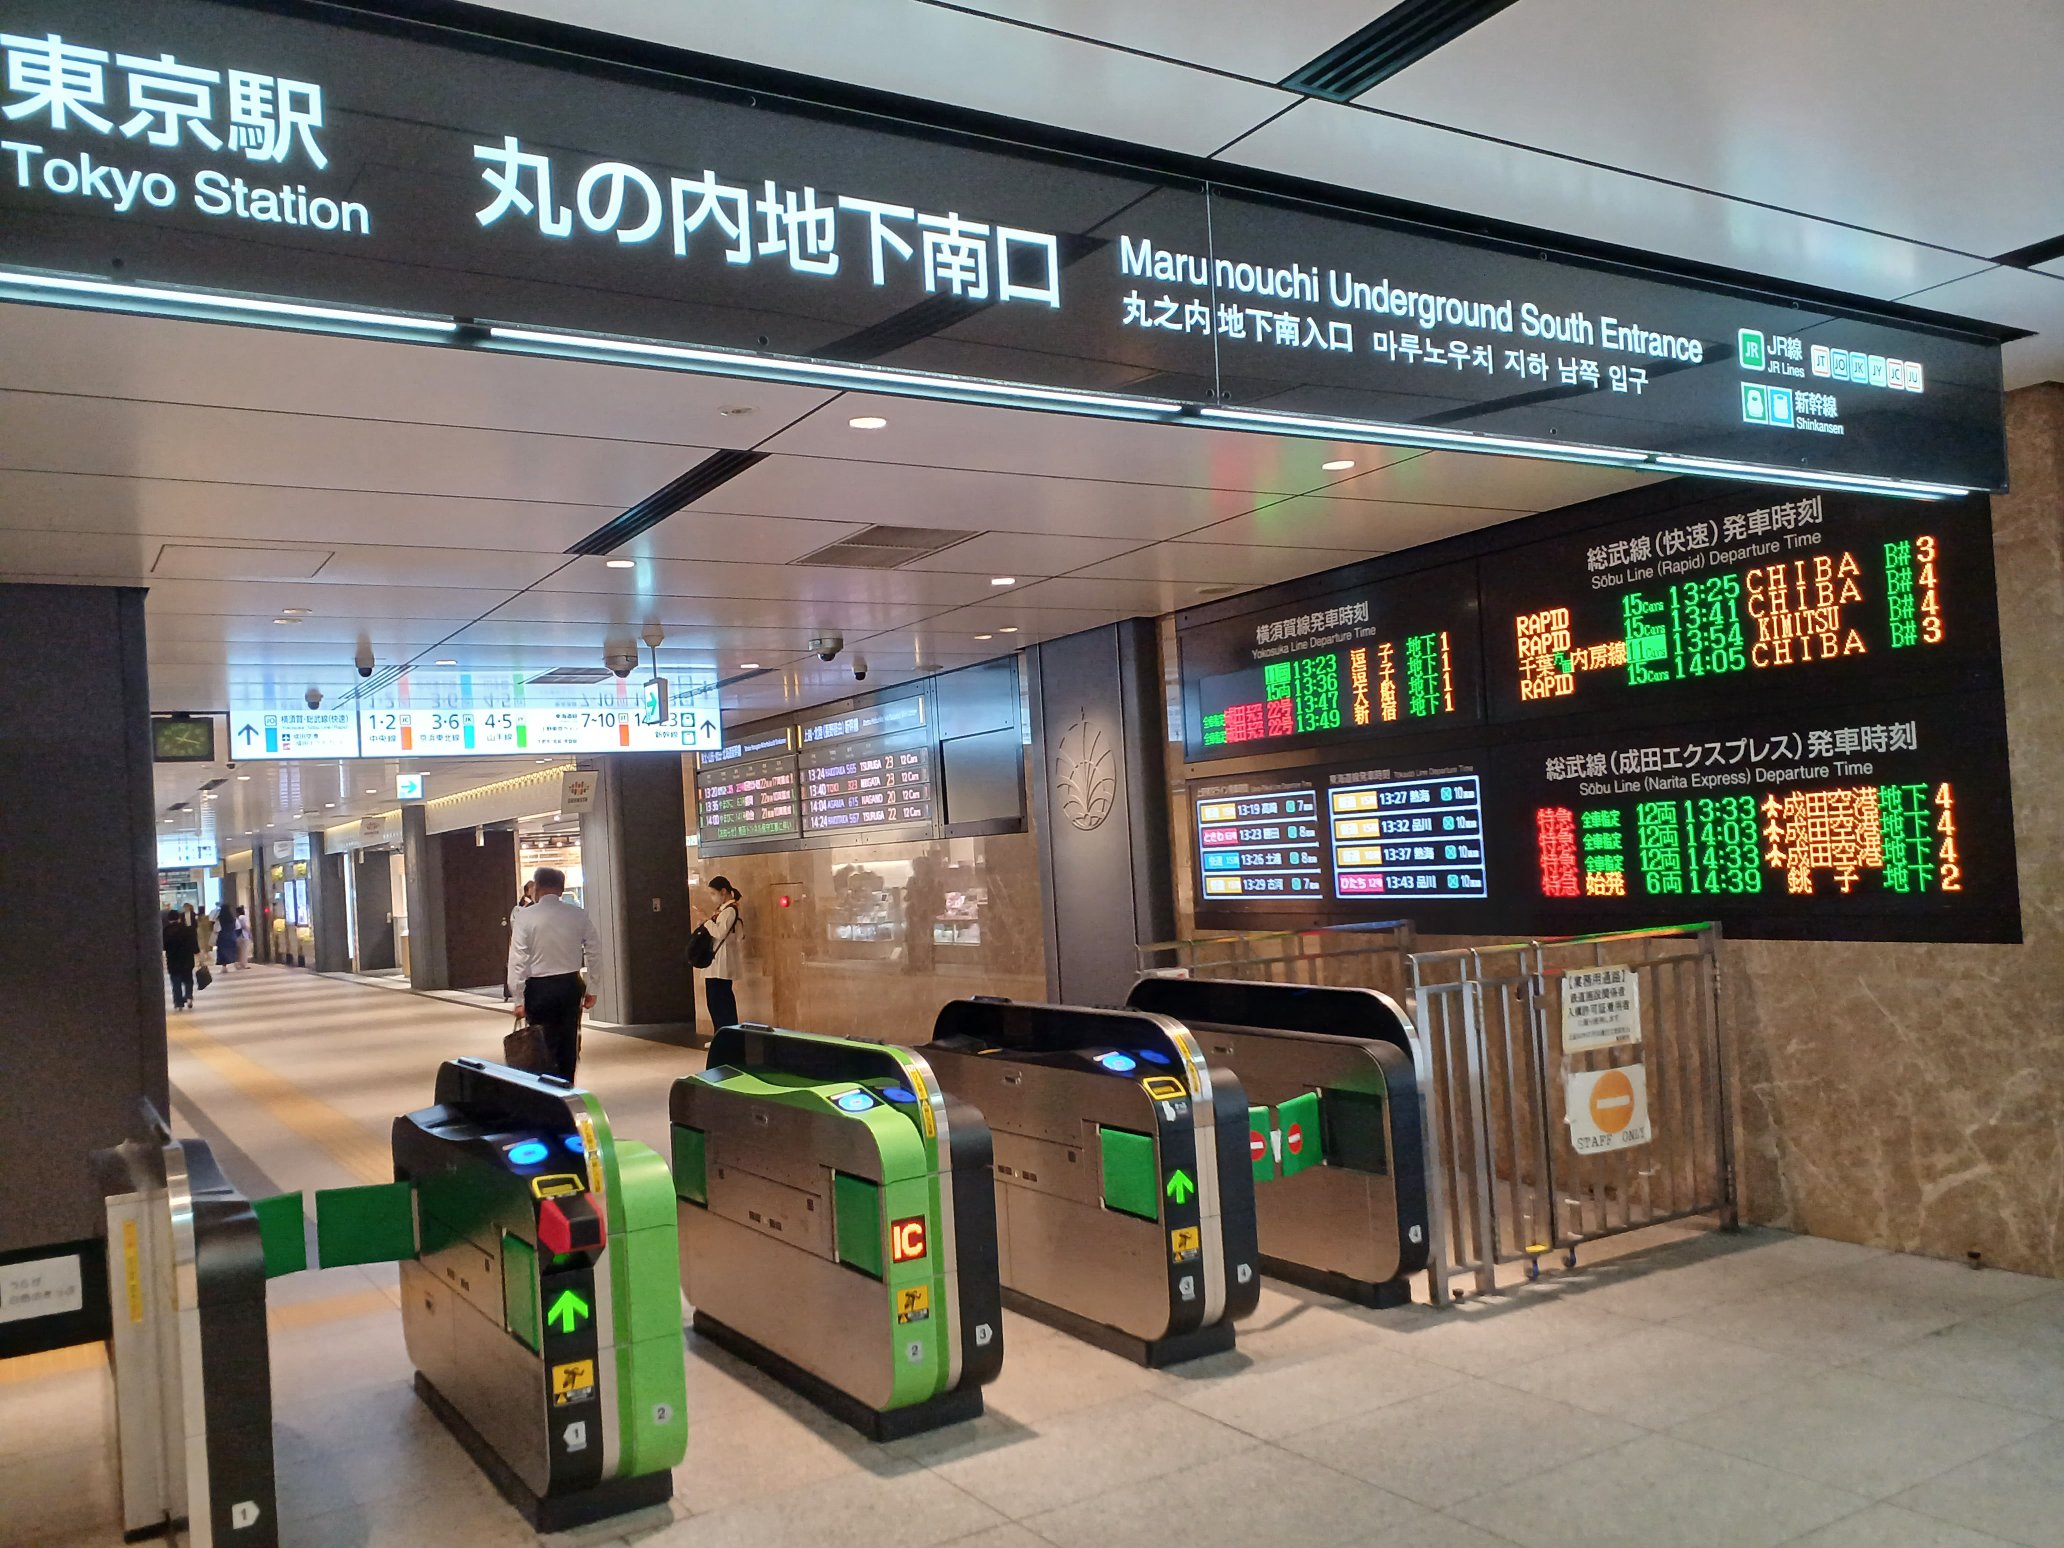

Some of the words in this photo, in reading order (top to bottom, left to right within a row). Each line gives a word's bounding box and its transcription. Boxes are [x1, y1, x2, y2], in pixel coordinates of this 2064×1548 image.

[0, 34, 328, 170] 東京駅
[1, 140, 177, 212] Tokyo
[194, 169, 371, 235] Station
[473, 136, 1060, 308] 丸の内地下南口
[1120, 234, 1318, 300] Marunouchi
[1329, 272, 1514, 332] Underground
[1521, 301, 1593, 339] South
[1601, 317, 1703, 364] Entrance
[1122, 289, 1353, 353] 丸之内地下南入口
[1373, 330, 1494, 375] 마루노우치
[1504, 348, 1548, 383] 지하
[1558, 356, 1600, 390] 남쪽
[1608, 364, 1649, 394] 입구
[1767, 335, 1803, 361] JR線
[1768, 360, 1781, 373] JR
[1782, 363, 1805, 378] Lines
[1834, 357, 1845, 371] JO
[1854, 361, 1864, 374] JK
[1872, 365, 1882, 377] JY
[1891, 368, 1900, 380] JC
[1909, 371, 1918, 383] JU
[1795, 390, 1838, 419] 新幹線
[1796, 417, 1844, 435] Shinkansen
[1591, 573, 1625, 590] Sōbu
[1627, 567, 1654, 582] Line
[1657, 556, 1705, 580] (Rapid)
[1710, 540, 1780, 569] Departure
[1785, 529, 1822, 553] Time
[1516, 607, 1571, 638] RAPID
[1669, 574, 1740, 609] 13:25
[1746, 552, 1860, 594] CHIBA
[1916, 535, 1935, 563] 3
[1256, 600, 1369, 645] 横須賀線発車時刻
[1518, 630, 1571, 659] RAPID
[1671, 600, 1740, 632] 13:41
[1748, 578, 1863, 620] CHIBA
[1919, 562, 1937, 588] 4
[1673, 622, 1744, 656] 13:54
[1757, 605, 1840, 642] KIMITSU
[1921, 590, 1939, 615] 4
[1252, 643, 1290, 660] Yokosuka
[1290, 640, 1308, 653] Line
[1310, 631, 1352, 650] Departure
[1354, 625, 1377, 640] Time
[1293, 653, 1338, 679] 13:23
[1405, 632, 1437, 656] 地下
[1440, 631, 1450, 652] 1
[1520, 673, 1574, 701] RAPID
[1675, 646, 1747, 680] 14:05
[1750, 629, 1867, 668] CHIBA
[1922, 616, 1942, 643] 3
[1294, 672, 1338, 698] 13:36
[1407, 652, 1438, 676] 地下
[1441, 651, 1451, 672] 1
[1296, 691, 1339, 715] 13:47
[1408, 673, 1439, 697] 地下
[1442, 671, 1452, 692] 1
[1297, 709, 1341, 733] 13:49
[1409, 694, 1440, 717] 地下
[1443, 691, 1454, 712] 1
[808, 767, 825, 781] 13:24
[885, 756, 894, 768] 23
[809, 784, 826, 797] 13:40
[886, 773, 895, 785] 23
[1579, 780, 1611, 797] Sōbu
[1614, 778, 1641, 794] Line
[1644, 774, 1688, 793] (Narita
[1692, 768, 1752, 790] Express)
[1756, 764, 1829, 787] Departure
[1833, 759, 1874, 777] Time
[810, 799, 827, 812] 14:04
[887, 790, 896, 803] 20
[1238, 803, 1260, 816] 13:19
[1379, 791, 1407, 806] 13:27
[1636, 801, 1678, 826] 12両
[1685, 795, 1756, 826] 13:33
[1784, 786, 1878, 821] 成田空港
[1877, 782, 1929, 817] 地下
[1934, 782, 1952, 807] 4
[811, 815, 828, 828] 14:24
[888, 807, 896, 820] 22
[1240, 828, 1262, 840] 13:23
[1381, 819, 1410, 833] 13:32
[1412, 818, 1432, 832] 品川
[1638, 824, 1679, 849] 12両
[1687, 819, 1758, 848] 14:03
[1879, 809, 1930, 841] 地下
[1936, 809, 1955, 834] 4
[1241, 854, 1264, 865] 13:26
[1383, 847, 1411, 861] 13:37
[1639, 847, 1681, 872] 12両
[1689, 844, 1760, 871] 14:33
[1880, 836, 1932, 865] 地下
[1939, 836, 1957, 862] 4
[1243, 879, 1266, 891] 13:29
[1386, 875, 1414, 888] 13:43
[1416, 875, 1437, 888] 品川
[1586, 871, 1626, 896] 始発
[1646, 870, 1683, 895] 6両
[1690, 868, 1762, 894] 14:39
[1787, 866, 1859, 894] 銚子
[1881, 862, 1934, 893] 地下
[1940, 864, 1962, 892] 2
[1577, 1134, 1613, 1150] STAFF
[1622, 1127, 1646, 1142] ONLY
[892, 1222, 924, 1260] IC
[911, 1344, 918, 1356] 2
[980, 1327, 987, 1339] 3
[657, 1407, 666, 1420] 2
